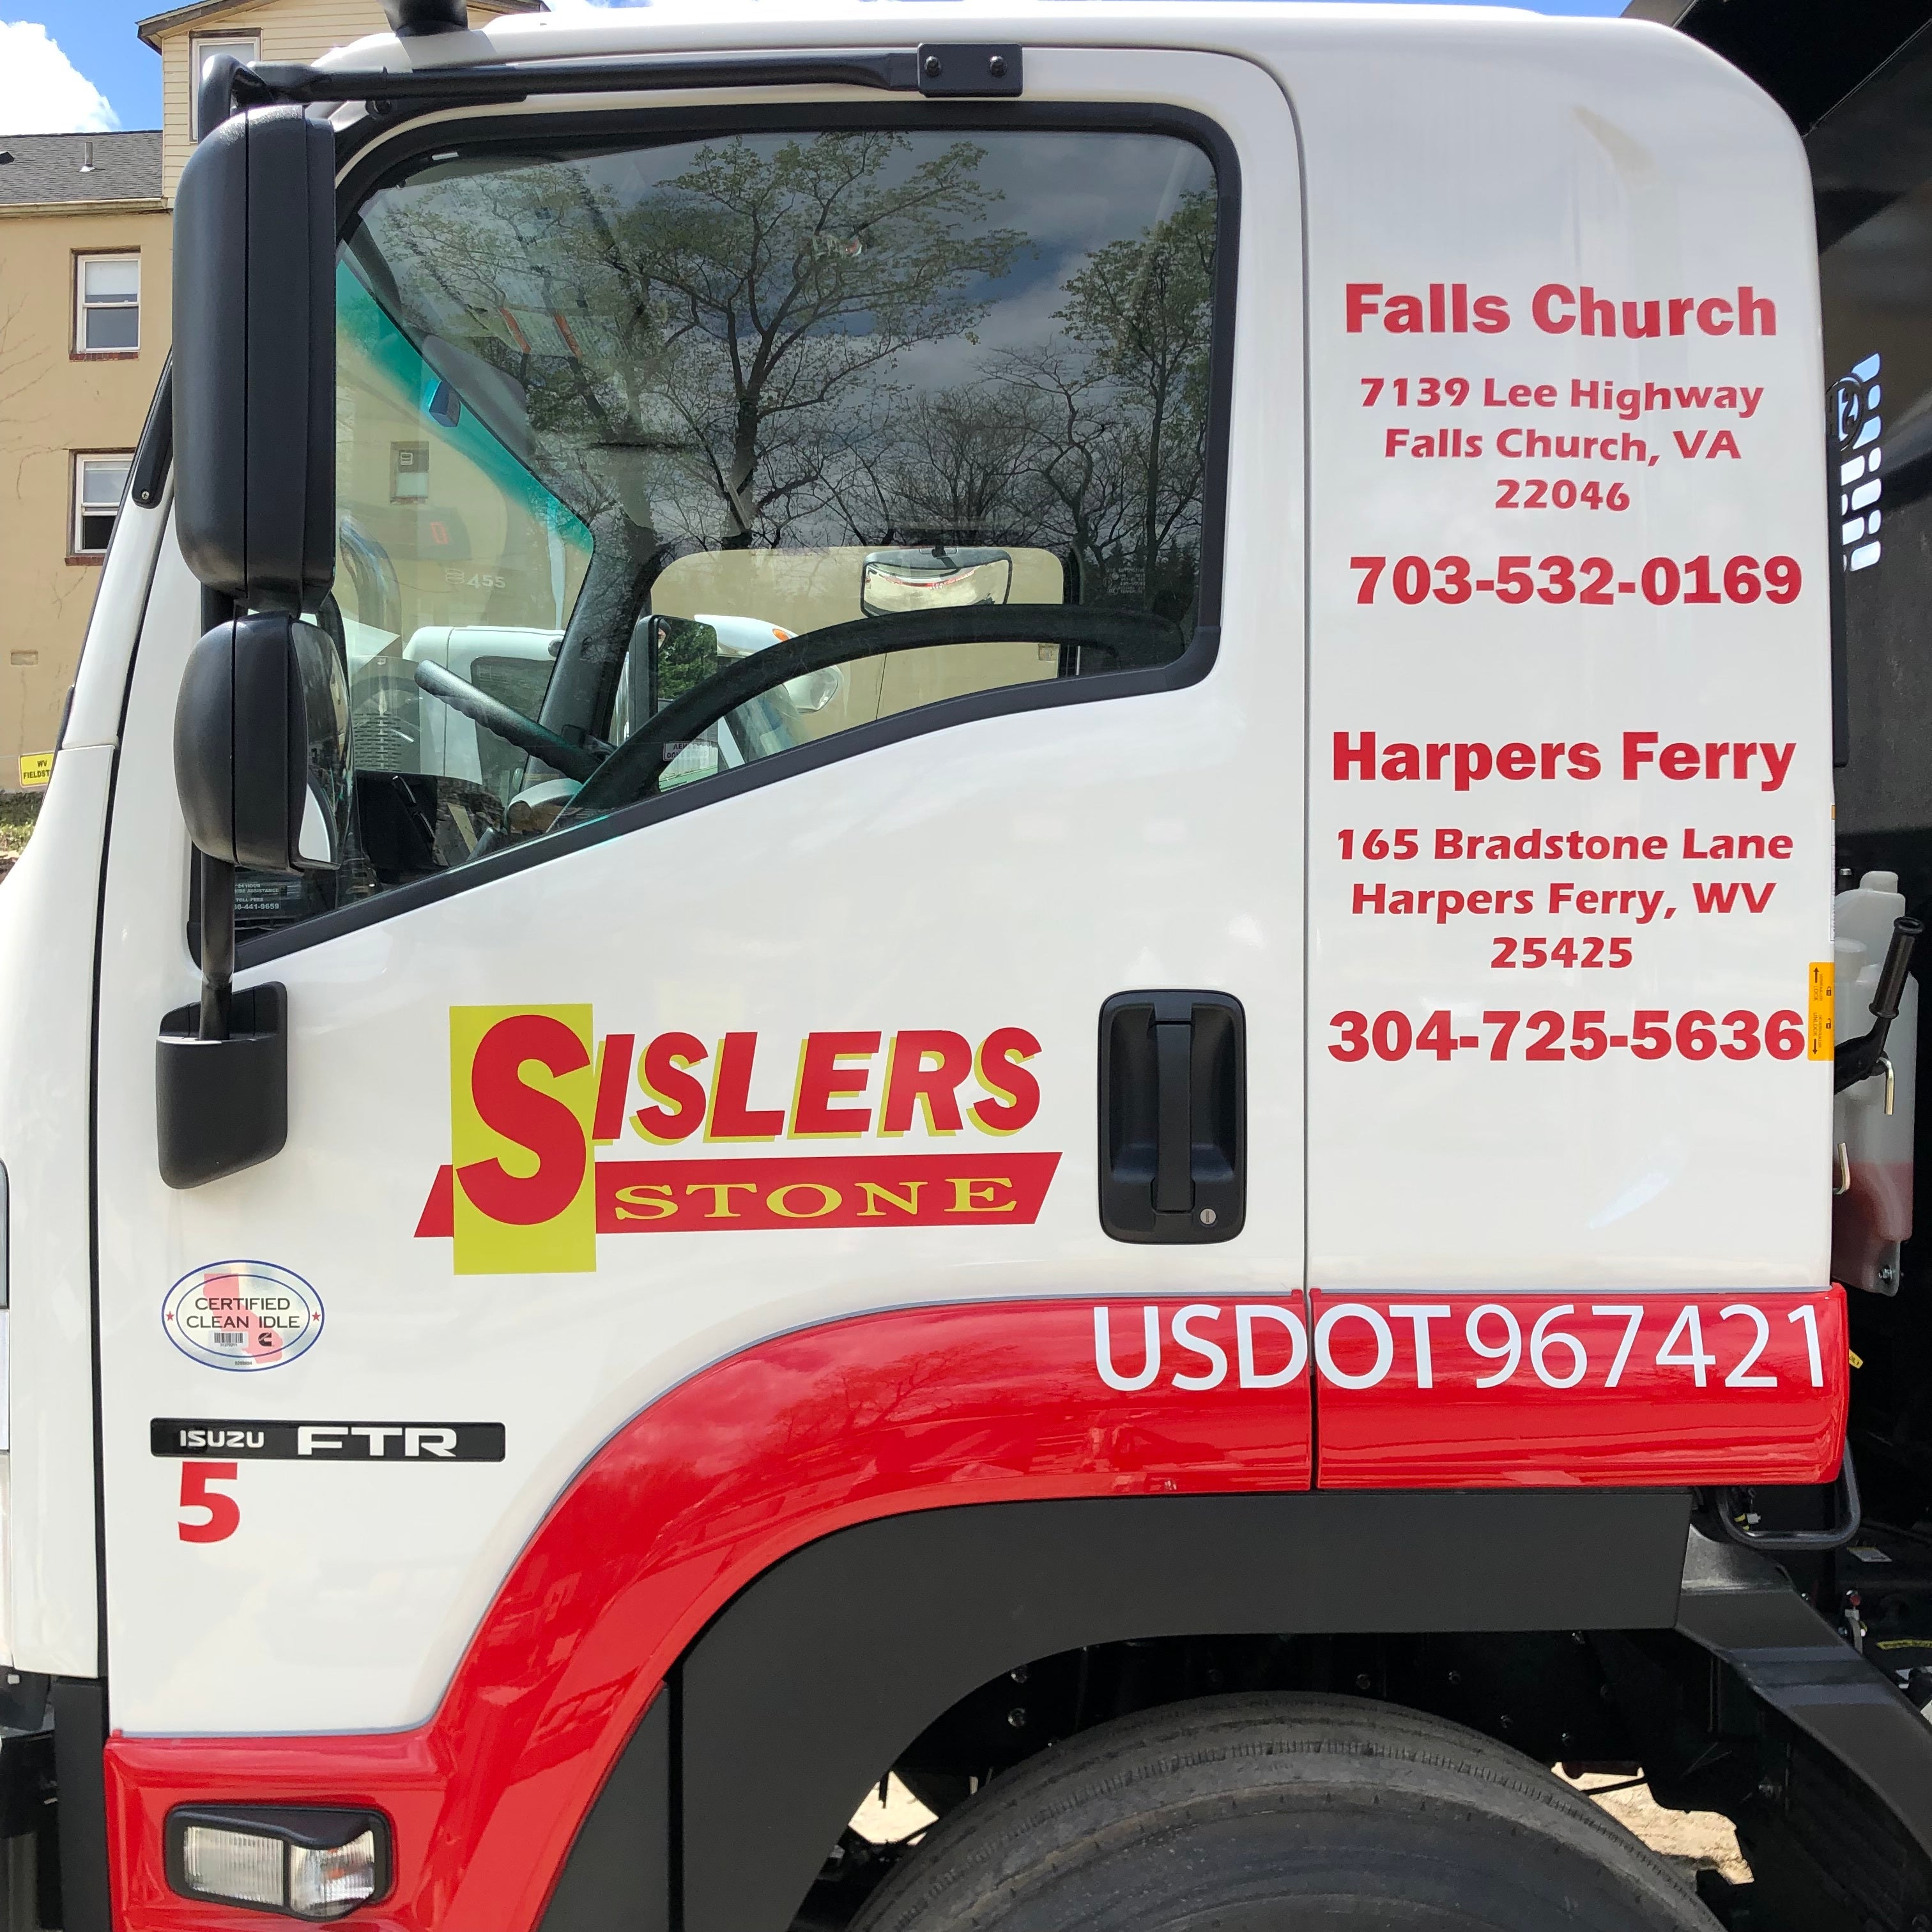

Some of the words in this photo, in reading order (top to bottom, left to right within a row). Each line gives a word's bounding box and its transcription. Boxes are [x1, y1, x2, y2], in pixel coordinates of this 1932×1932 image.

[1346, 284, 1510, 334] Falls
[1532, 284, 1775, 339] Church
[1361, 378, 1469, 407] 7139
[1484, 378, 1556, 407] Lee
[1571, 379, 1763, 420] Highway
[1386, 429, 1482, 457] Falls
[1496, 429, 1659, 466] Church,
[1673, 430, 1741, 459] VA
[1495, 480, 1630, 512] 22046
[1350, 555, 1802, 606] 703-532-0169
[37, 760, 48, 768] WV
[1333, 732, 1601, 791] Harpers
[1623, 732, 1796, 792] Ferry
[1338, 829, 1418, 860] 165
[1434, 828, 1667, 860] Bradstone
[1683, 828, 1793, 859] Lane
[1353, 884, 1533, 923] Harpers
[1549, 883, 1676, 922] Ferry,
[1693, 882, 1776, 914] WV
[1491, 936, 1633, 969] 25425
[1328, 1009, 1806, 1062] 304-725-5636
[456, 1015, 1041, 1225] SISLERS
[615, 1177, 1017, 1220] STONE
[186, 1315, 250, 1328] CLEAN
[259, 1315, 300, 1328] IDLE
[195, 1297, 291, 1310] CERTIFIED
[180, 1430, 264, 1448] ISUZU
[298, 1426, 457, 1457] FTR
[178, 1460, 241, 1544] 5
